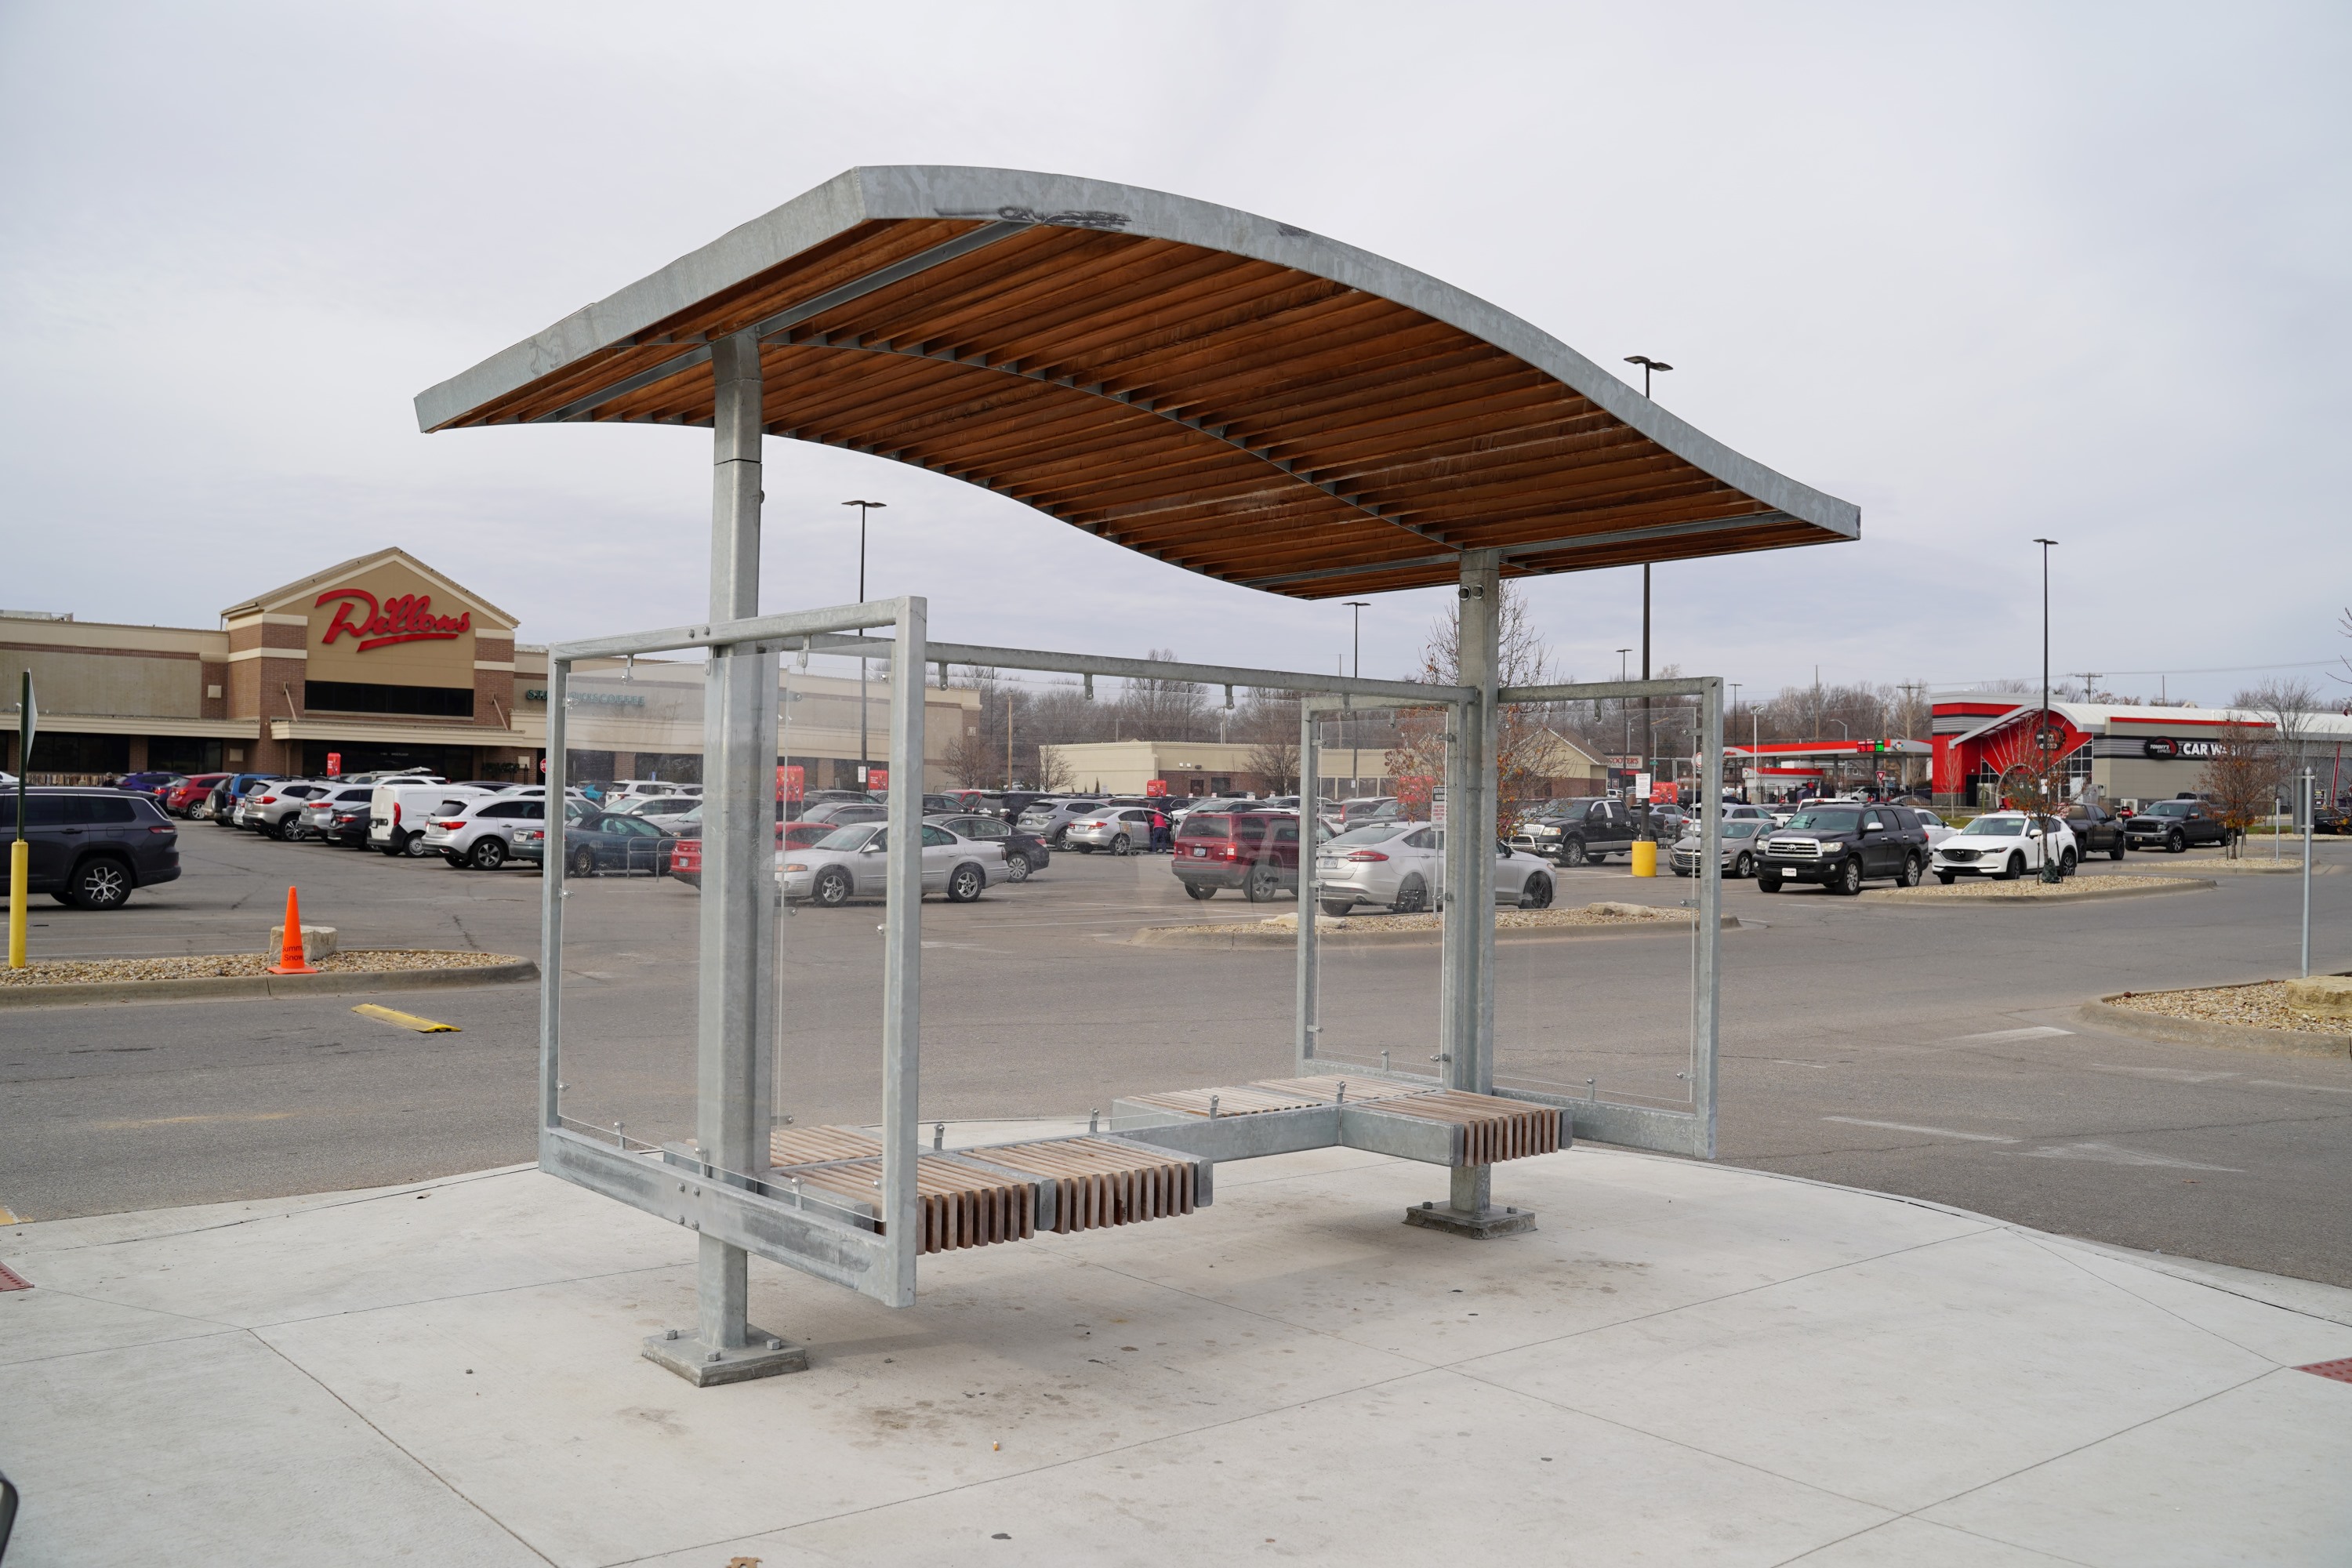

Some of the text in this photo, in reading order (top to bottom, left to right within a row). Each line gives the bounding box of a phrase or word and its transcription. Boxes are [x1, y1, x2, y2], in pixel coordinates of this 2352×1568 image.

[314, 589, 470, 644] Dillons
[527, 689, 598, 703] STABUCKS
[2183, 742, 2209, 755] CAR
